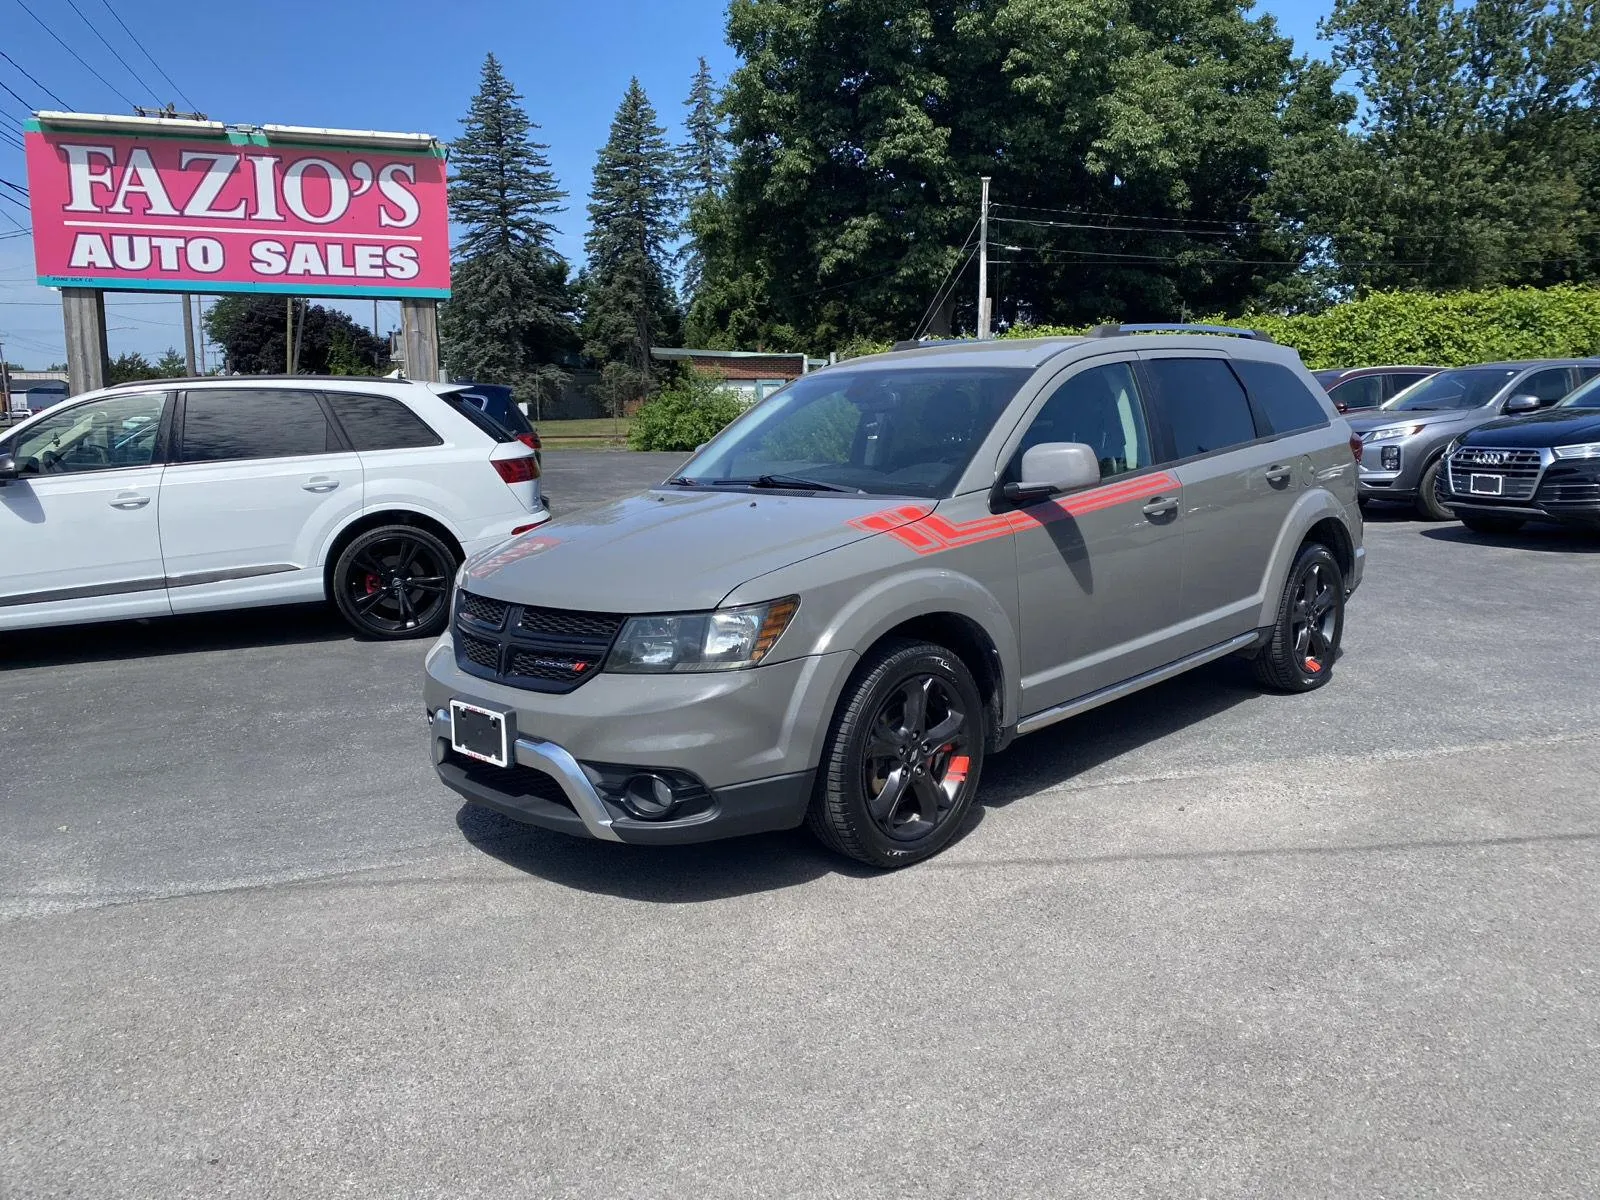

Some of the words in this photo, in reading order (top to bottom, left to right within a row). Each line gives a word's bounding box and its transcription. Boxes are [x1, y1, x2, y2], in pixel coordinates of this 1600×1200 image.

[58, 143, 421, 229] FAZIO'S
[69, 233, 225, 273] AUTO
[250, 239, 420, 279] SALES
